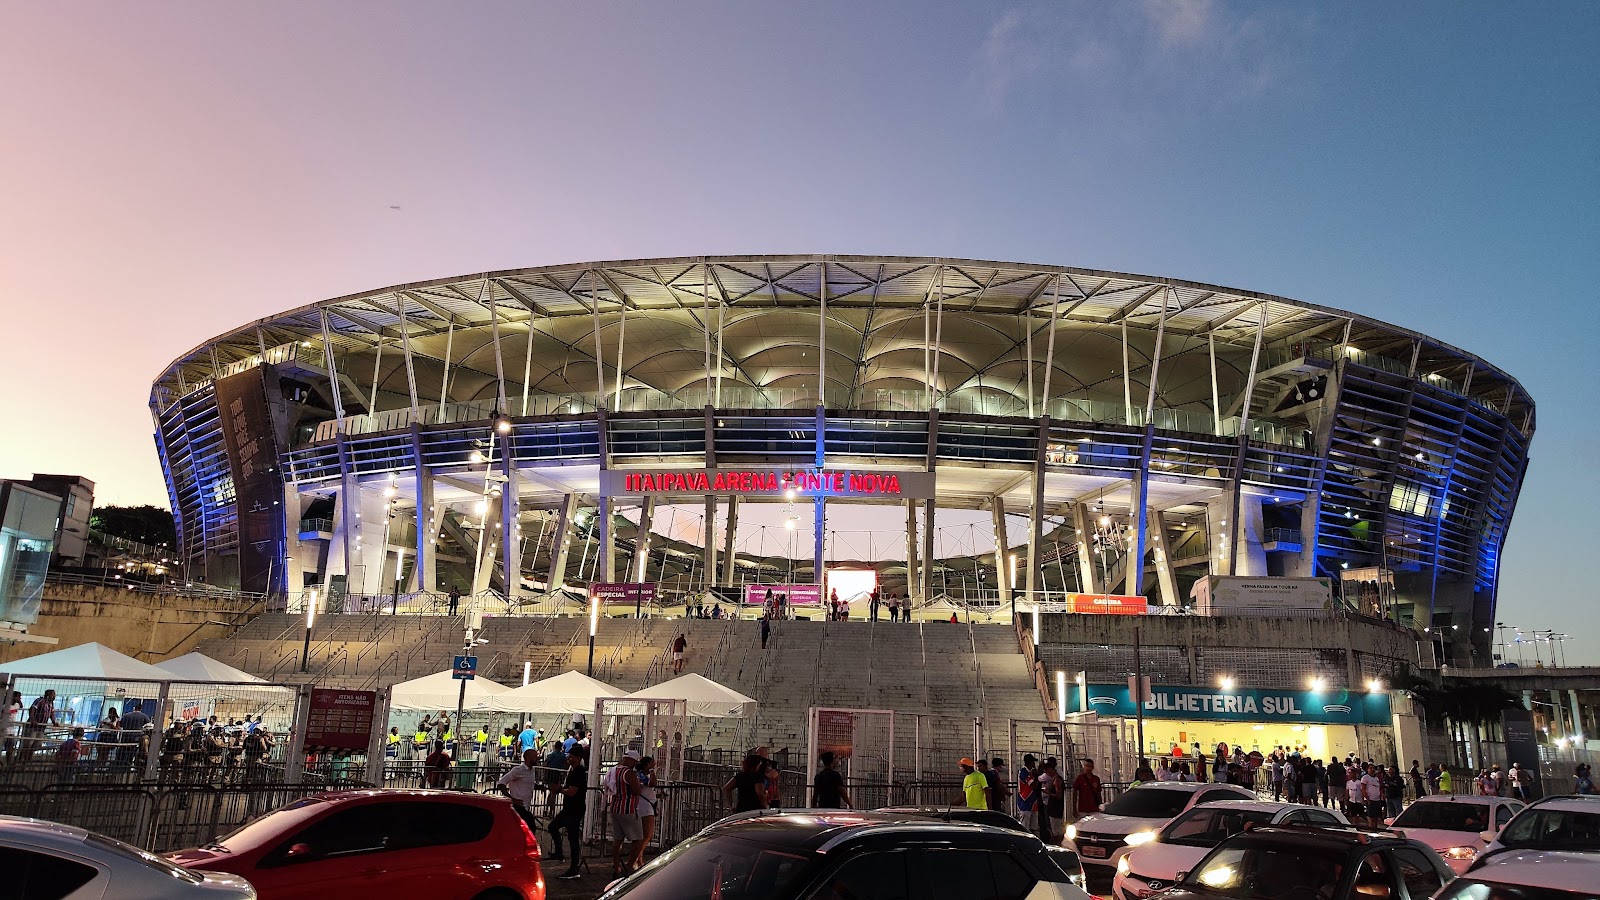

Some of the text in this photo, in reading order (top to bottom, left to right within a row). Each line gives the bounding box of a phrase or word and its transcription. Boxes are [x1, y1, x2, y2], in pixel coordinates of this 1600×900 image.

[626, 472, 710, 492] ITAIPAVA
[714, 472, 779, 492] ARENA
[849, 474, 901, 494] NOVA
[1145, 693, 1302, 715] BILHETERIA SUL
